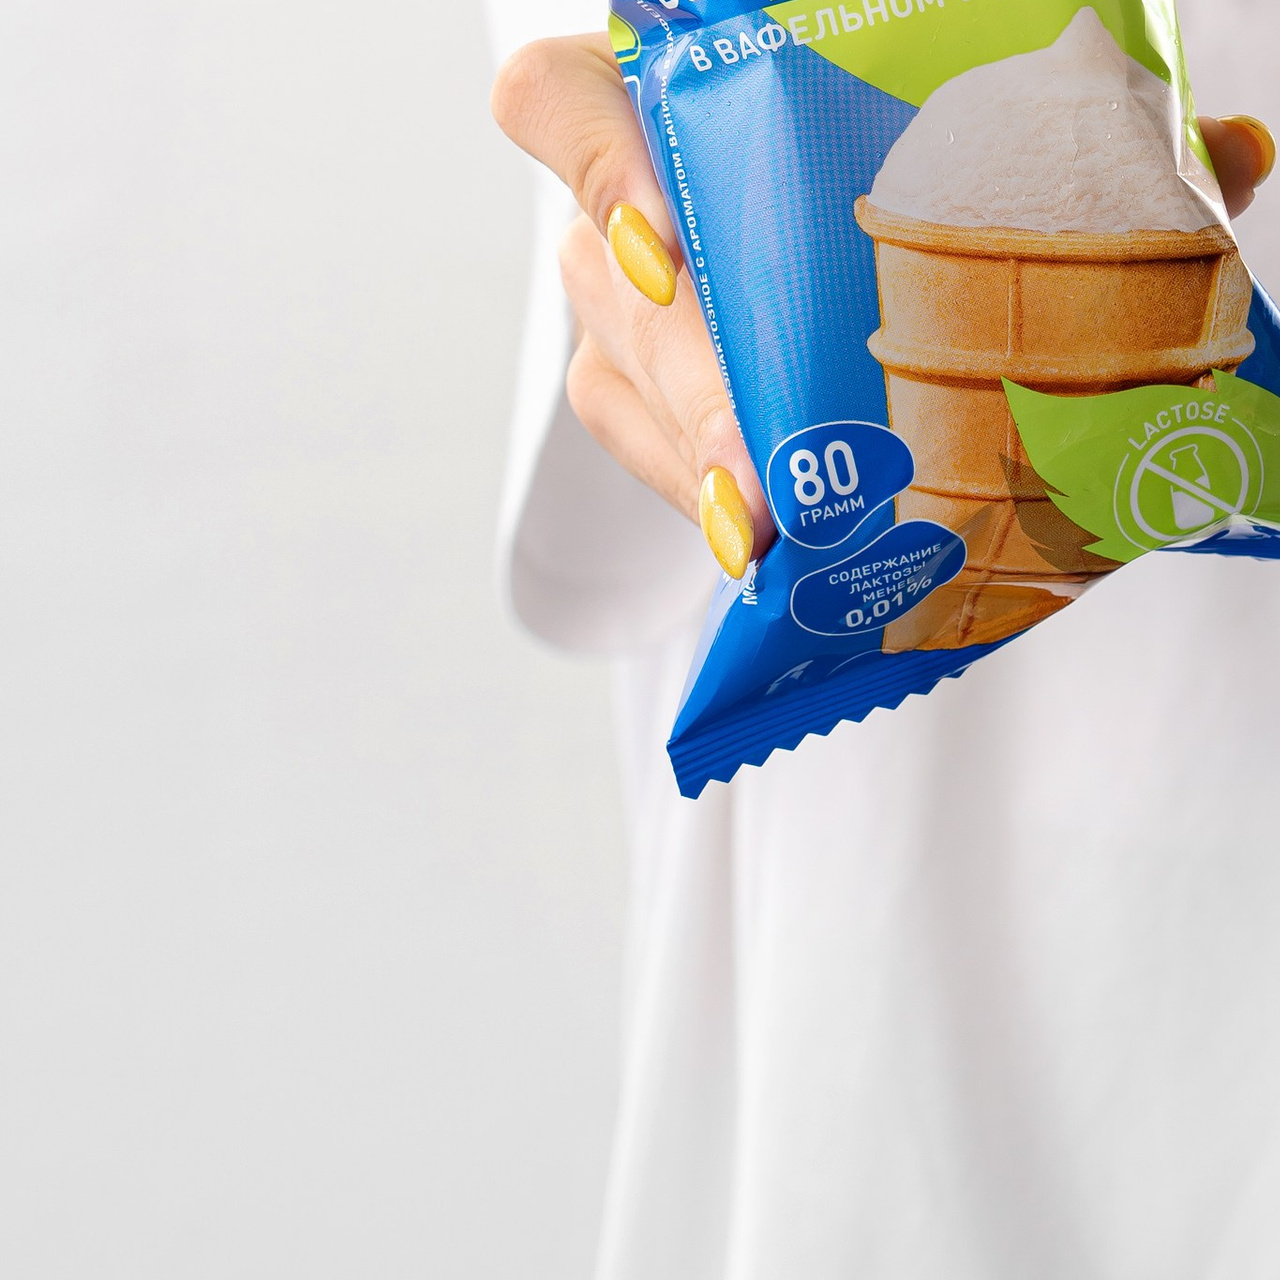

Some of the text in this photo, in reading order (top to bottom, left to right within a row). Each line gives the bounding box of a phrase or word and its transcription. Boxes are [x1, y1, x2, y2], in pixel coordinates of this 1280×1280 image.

[689, 45, 713, 72] В
[660, 75, 678, 147] ВАНИЛИ
[672, 152, 702, 251] АРОМАТОМ
[1128, 401, 1231, 451] LACTOSE
[789, 440, 859, 506] 80
[800, 495, 865, 527] ГРАММ
[828, 543, 941, 585] СОДЕРЖАНИЕ
[849, 561, 926, 595] ЛАКТОЗЫ
[845, 575, 932, 628] 0,01%
[862, 575, 915, 603] МЕНЕЕ
